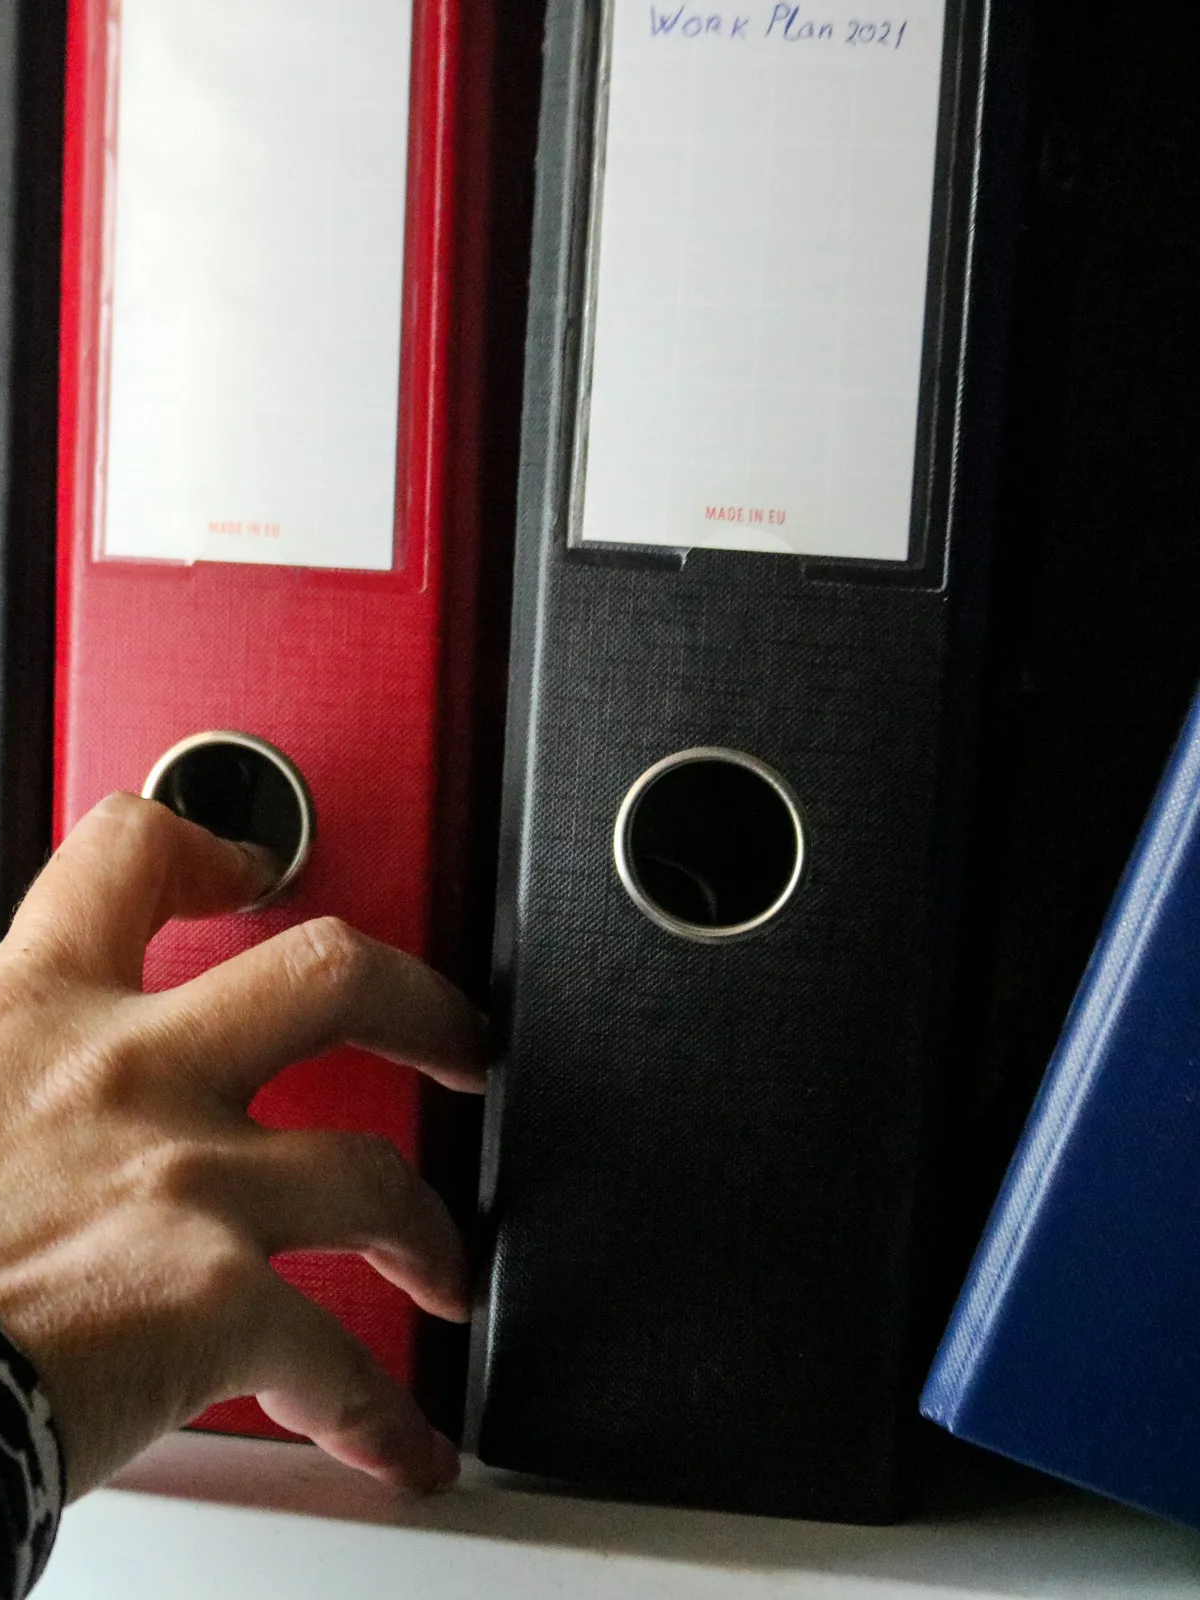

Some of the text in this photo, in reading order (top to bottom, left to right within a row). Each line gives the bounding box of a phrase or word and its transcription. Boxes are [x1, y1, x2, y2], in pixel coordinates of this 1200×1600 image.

[844, 18, 907, 50] 2021
[704, 505, 786, 525] MADE IN EU
